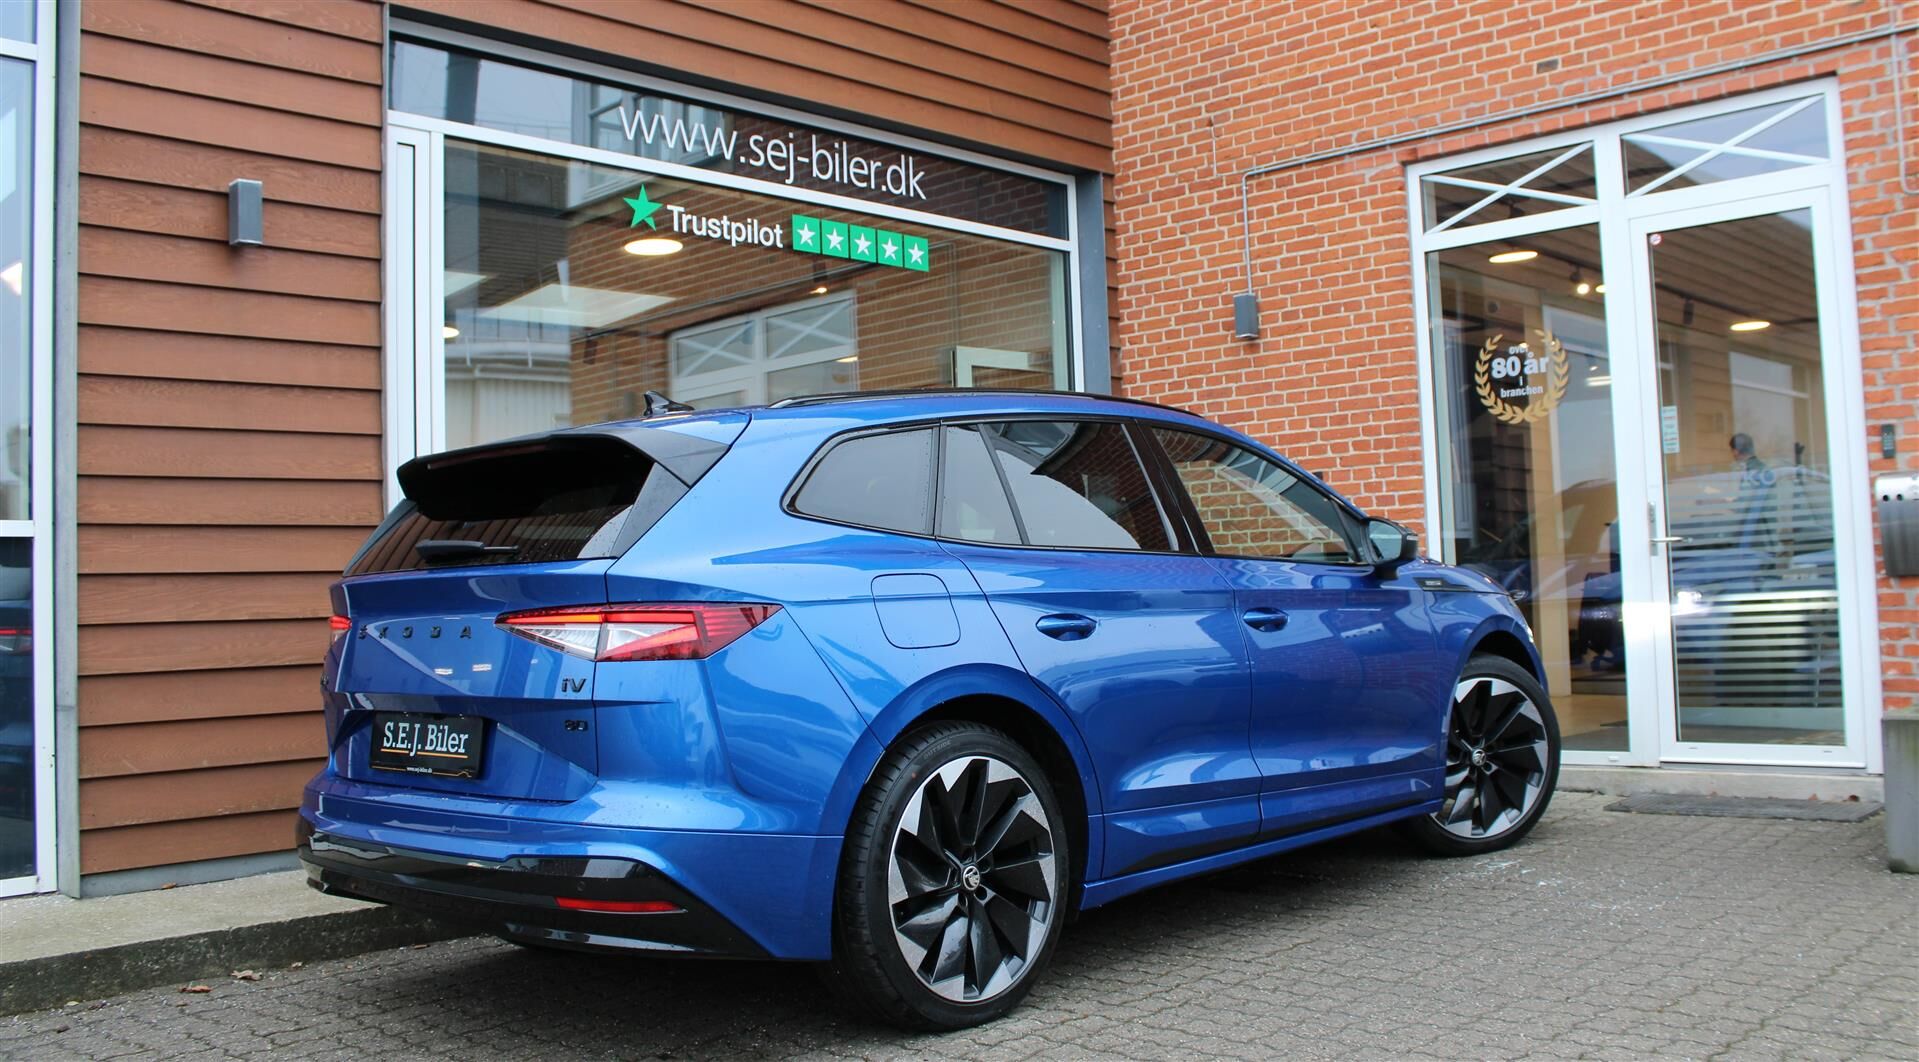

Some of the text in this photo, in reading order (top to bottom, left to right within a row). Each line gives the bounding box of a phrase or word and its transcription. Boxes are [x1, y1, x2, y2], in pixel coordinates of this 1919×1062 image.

[619, 106, 927, 200] www.sej-biler.dk
[666, 204, 784, 249] Trustpilot
[1491, 352, 1549, 378] 80 år
[1500, 386, 1543, 398] branchen
[382, 721, 469, 757] S.E.J. Biler
